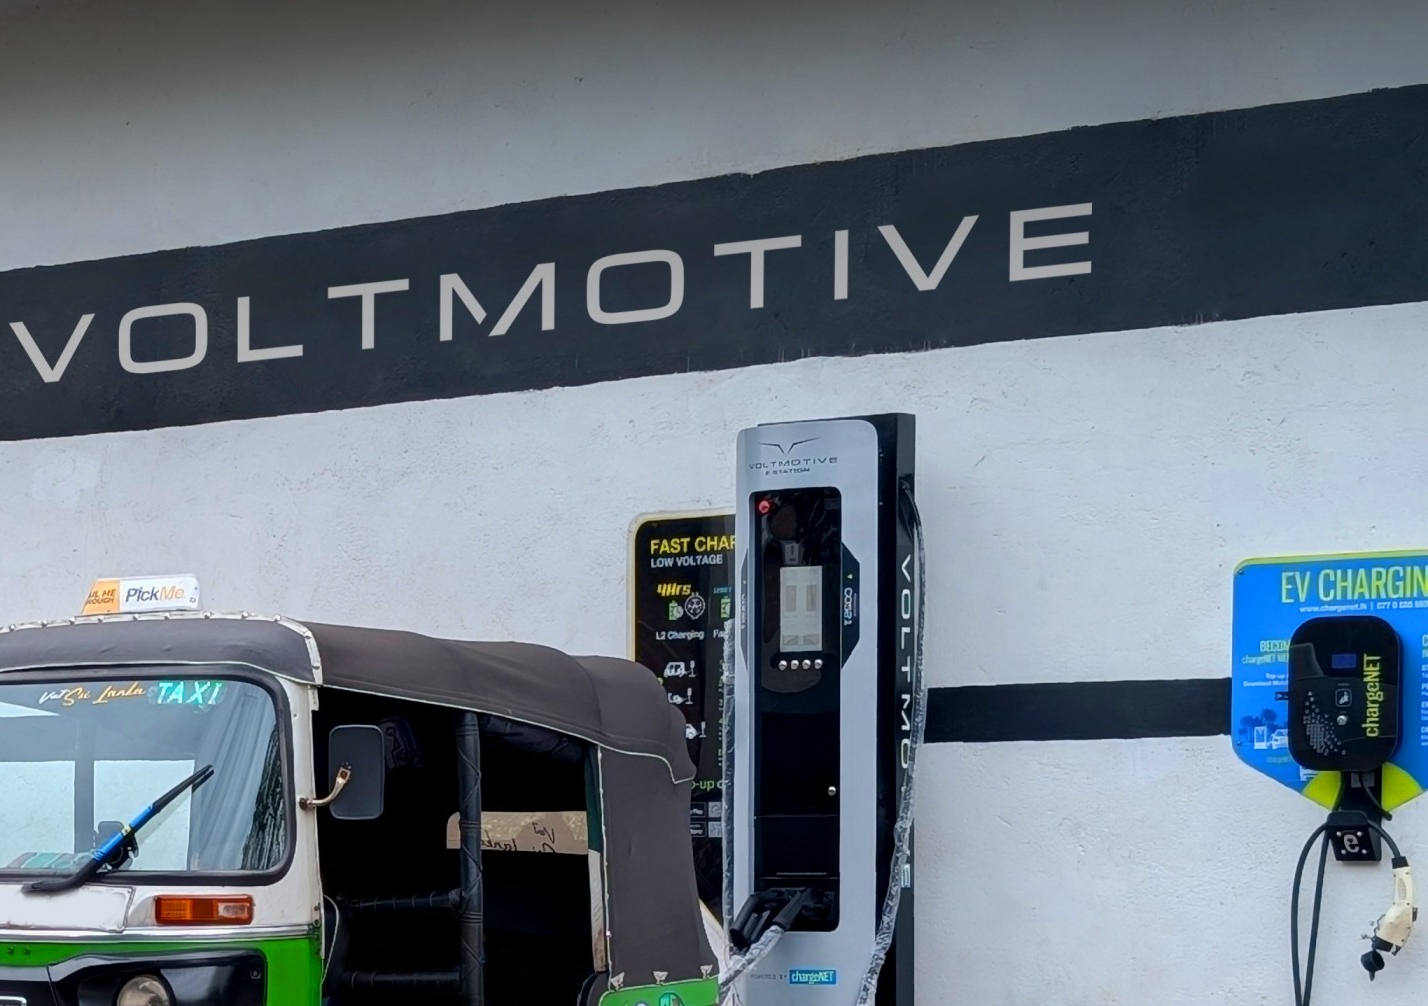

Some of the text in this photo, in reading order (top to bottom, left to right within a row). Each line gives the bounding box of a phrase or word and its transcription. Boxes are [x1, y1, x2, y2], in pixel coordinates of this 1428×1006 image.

[9, 202, 1093, 383] VOLTMOTIVE
[749, 457, 838, 469] VOLTMOTIVE
[650, 537, 691, 555] FAST
[650, 553, 723, 569] LOW VOLTAGE
[125, 586, 185, 603] PickMe
[1281, 571, 1311, 604] EV
[667, 630, 705, 641] Charging
[157, 680, 224, 705] TAXI
[1360, 652, 1384, 738] chargeNET
[792, 970, 834, 985] chargeNET
